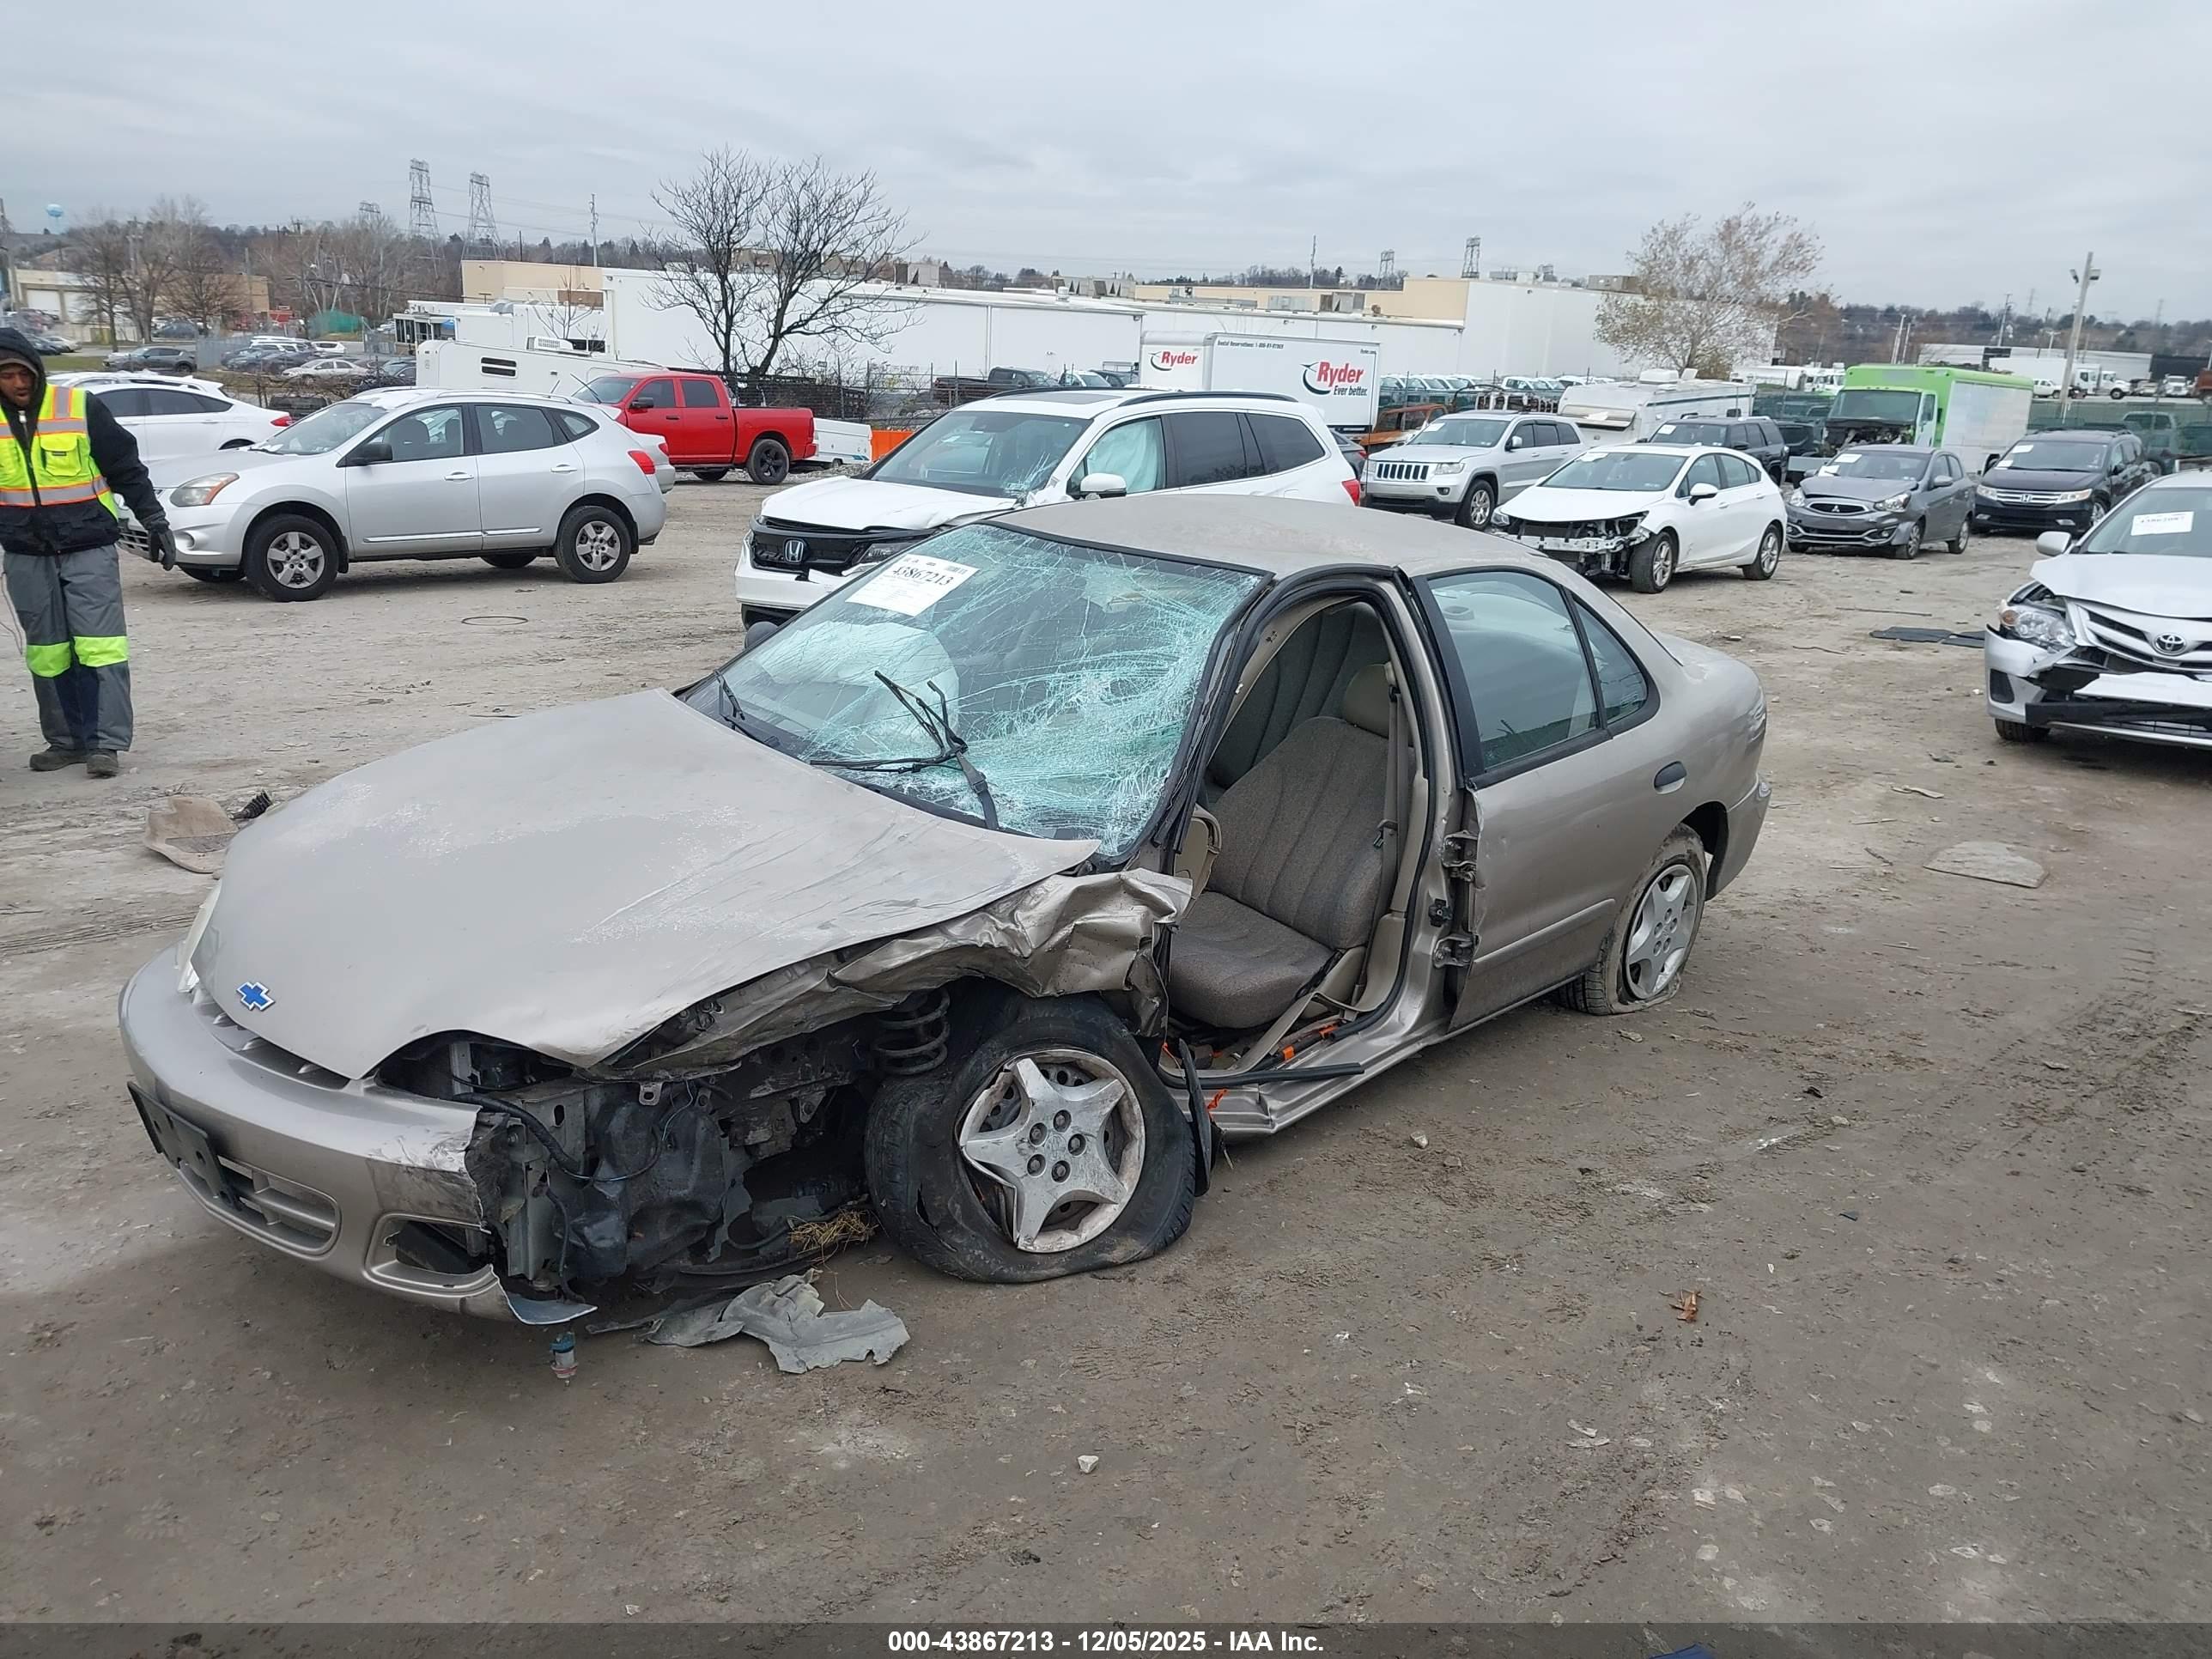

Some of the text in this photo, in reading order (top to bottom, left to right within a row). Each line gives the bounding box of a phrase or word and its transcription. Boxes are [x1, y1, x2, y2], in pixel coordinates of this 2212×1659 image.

[1161, 351, 1198, 367] Ryder
[1317, 362, 1364, 387] Ryder
[1334, 386, 1368, 396] Ever better.
[892, 566, 954, 586] 43867213
